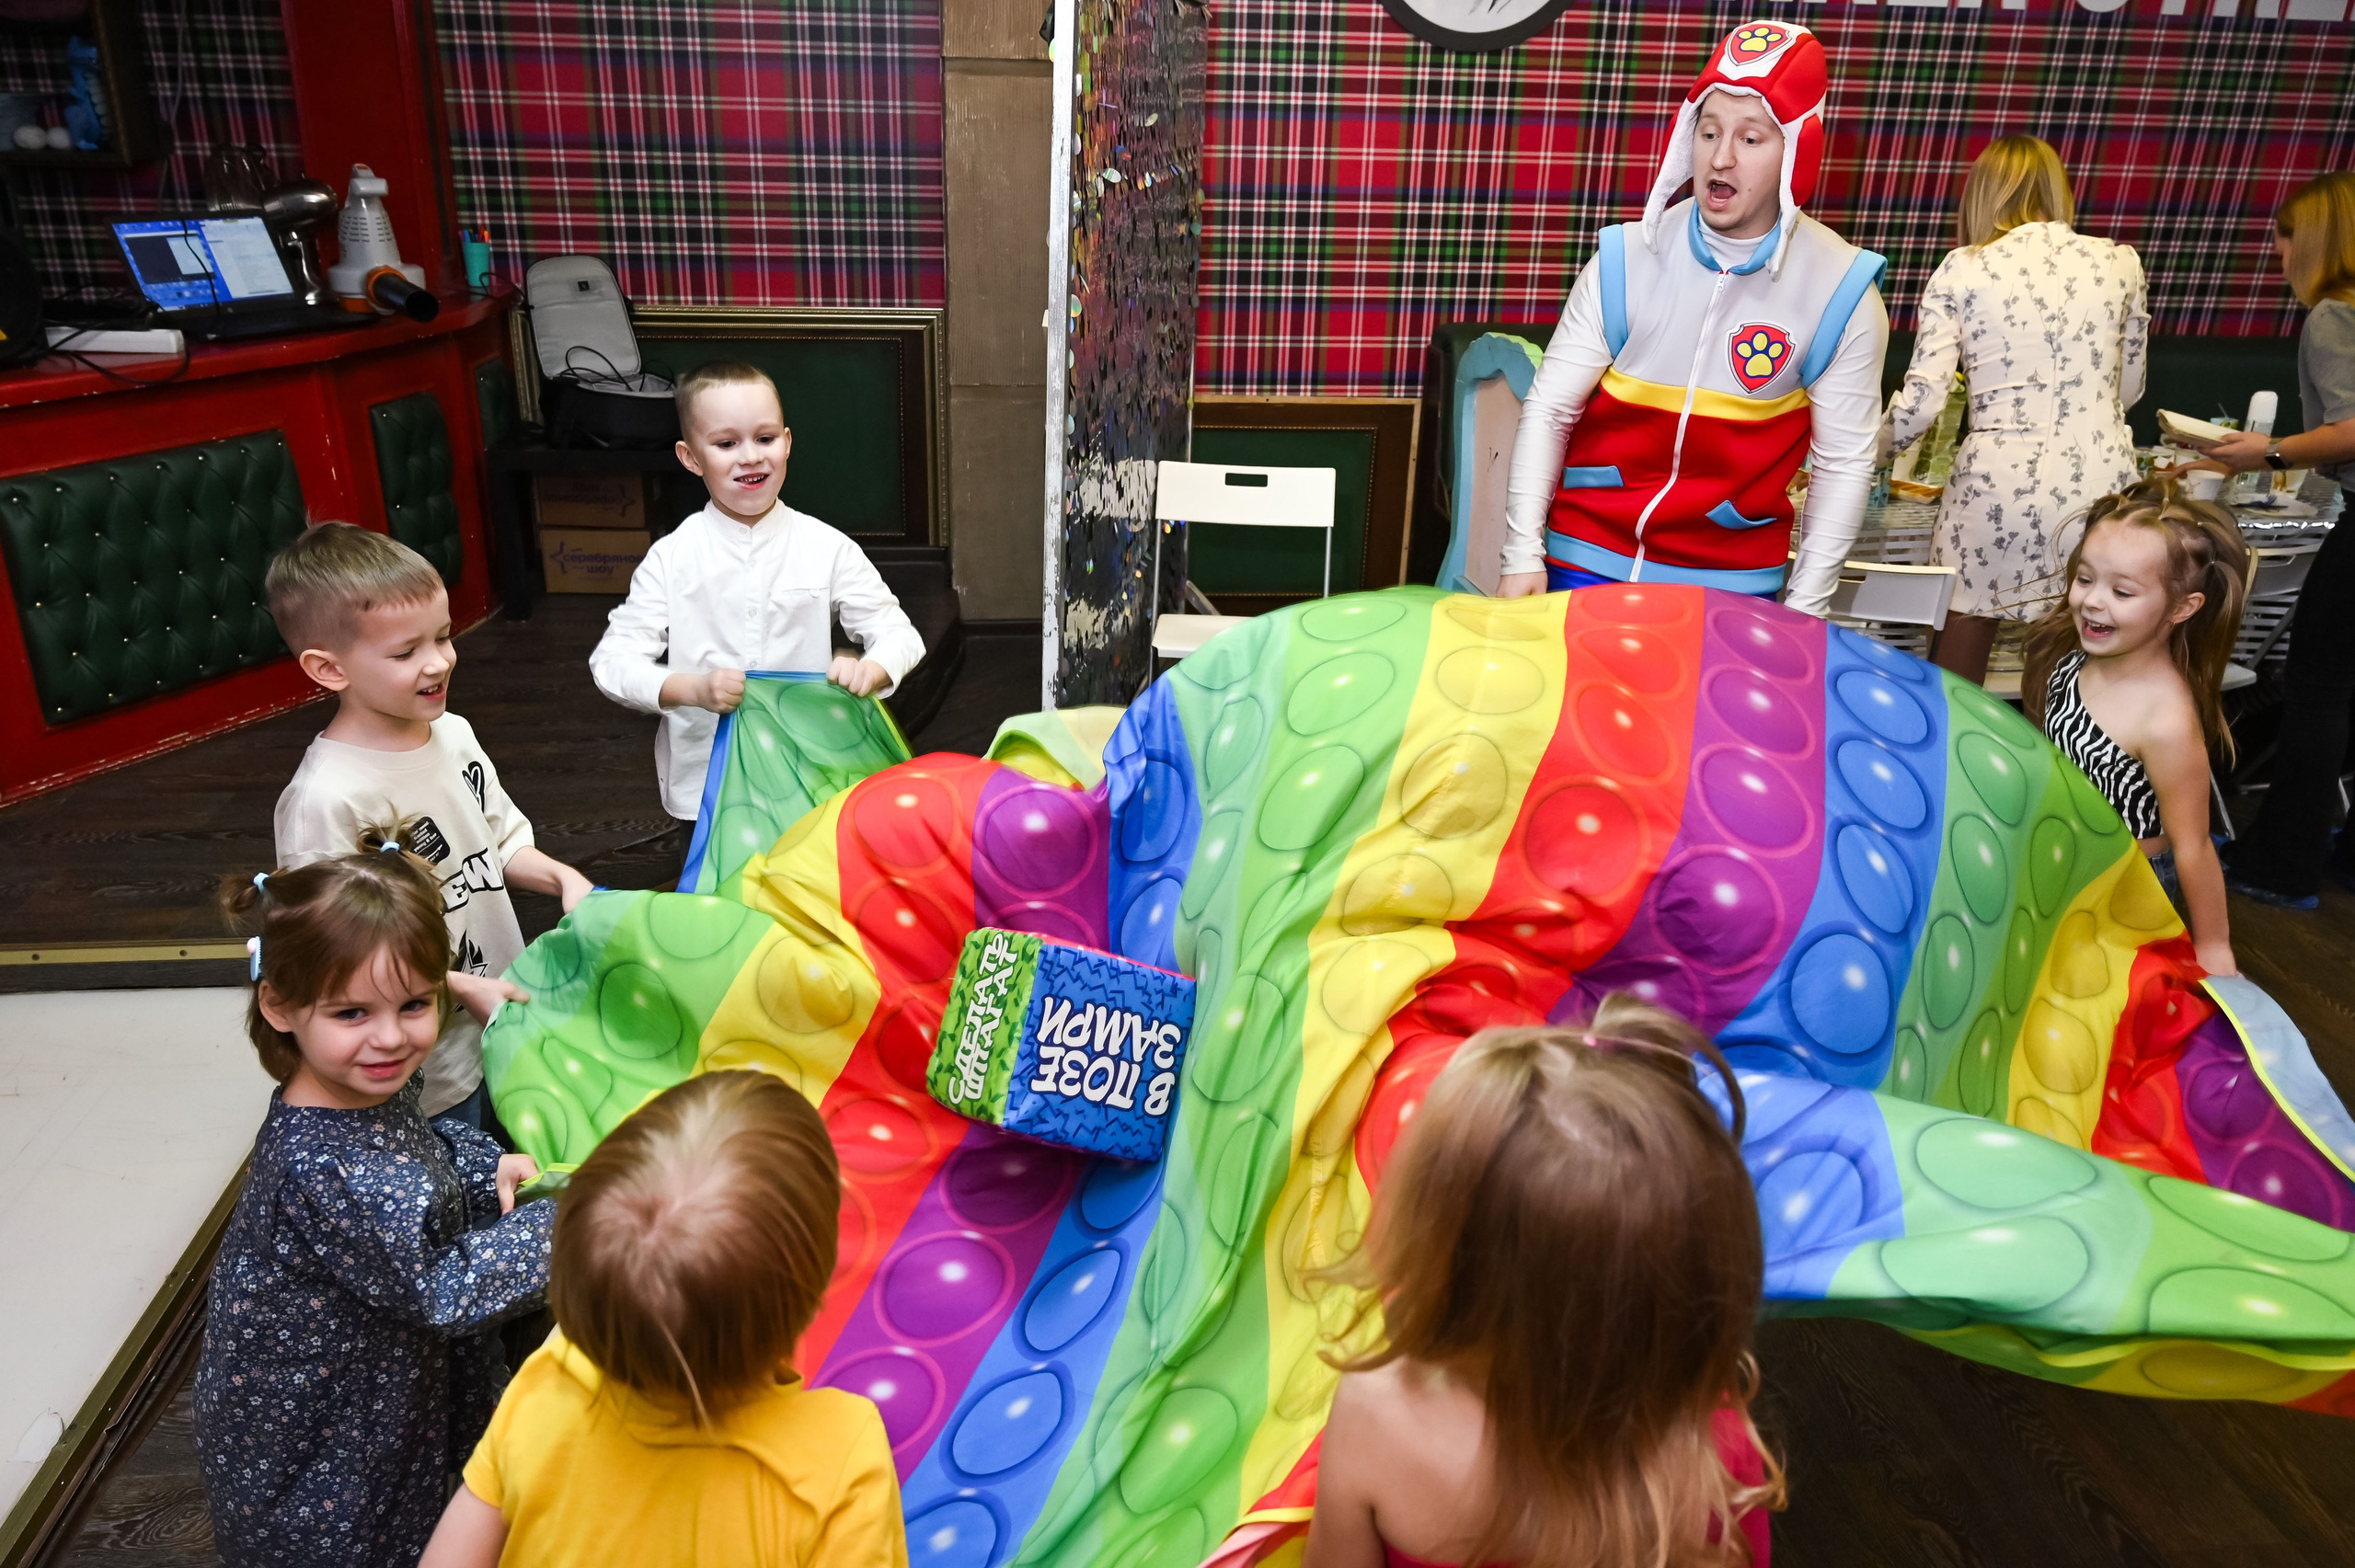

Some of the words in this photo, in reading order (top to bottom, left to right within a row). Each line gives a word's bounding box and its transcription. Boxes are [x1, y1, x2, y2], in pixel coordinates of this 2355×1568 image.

[587, 565, 614, 575] шоу
[439, 848, 504, 911] EW
[948, 933, 1004, 1104] СДЕЛАТЬ
[966, 939, 1017, 1099] ШПАГАТ
[1037, 996, 1181, 1069] ЗАМРИ
[1031, 1046, 1141, 1109] ПОЗЕ
[1144, 1072, 1175, 1116] В
